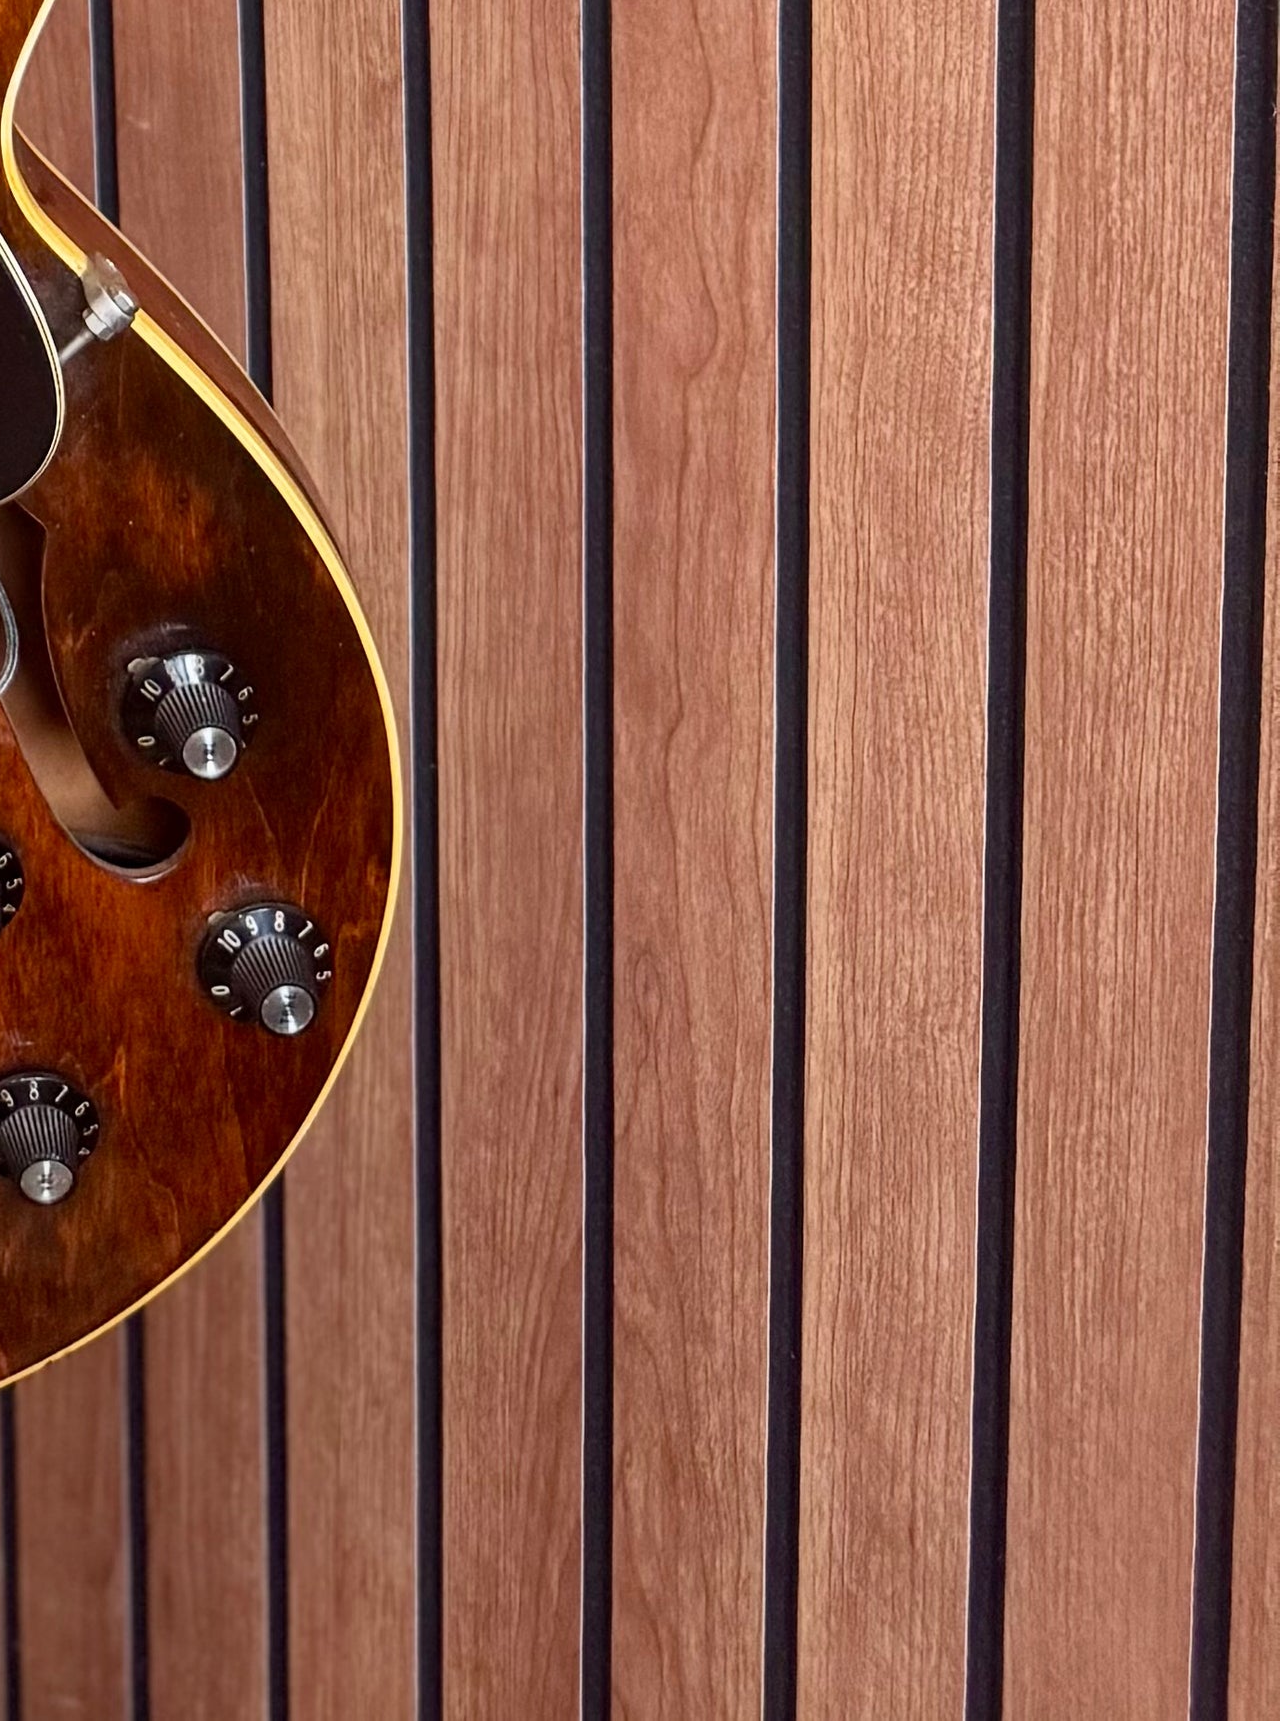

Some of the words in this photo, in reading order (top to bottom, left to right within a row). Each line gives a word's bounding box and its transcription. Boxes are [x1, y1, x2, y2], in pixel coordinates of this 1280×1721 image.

[140, 679, 162, 702] 10
[220, 664, 234, 681] 7
[238, 686, 253, 700] 6
[6, 878, 22, 889] 5
[245, 915, 258, 935] 9
[274, 911, 284, 932] 8
[298, 920, 313, 938] 7
[217, 929, 241, 953] 10
[314, 943, 328, 957] 6
[316, 970, 331, 981] 5
[211, 985, 230, 995] 0
[0, 1089, 14, 1107] 9
[29, 1080, 39, 1100] 8
[55, 1085, 68, 1102] 7
[75, 1101, 89, 1116] 6
